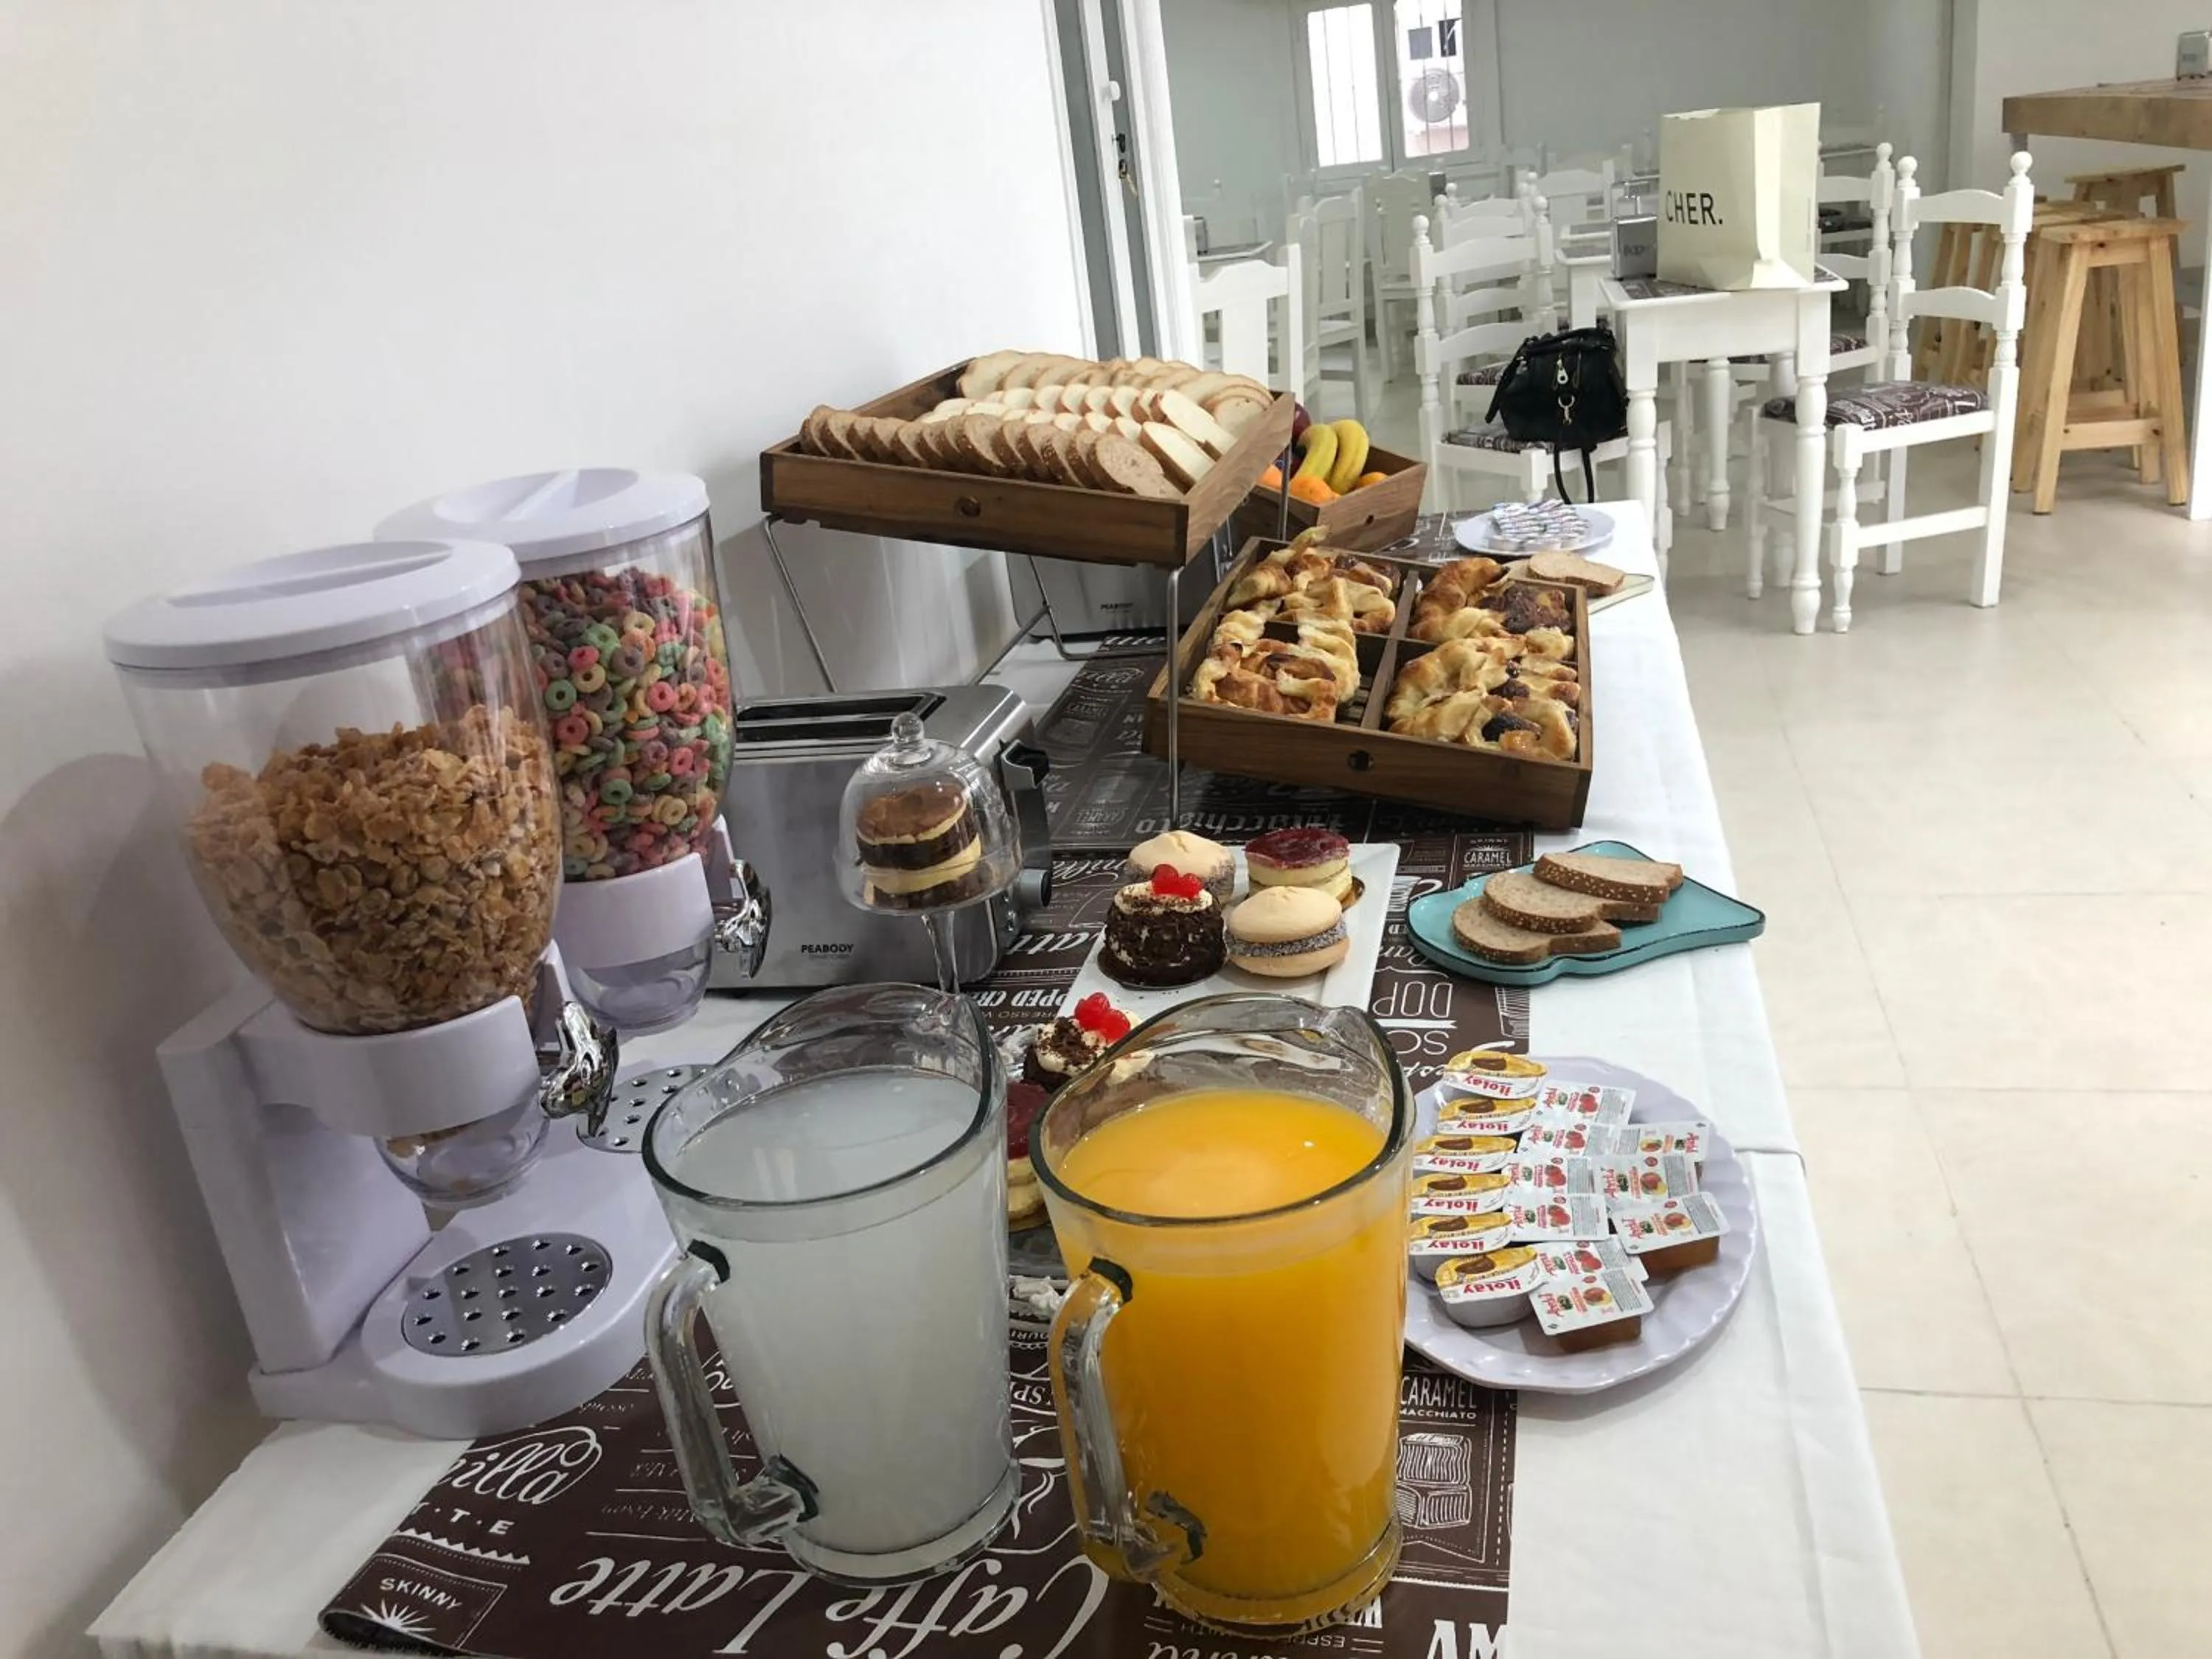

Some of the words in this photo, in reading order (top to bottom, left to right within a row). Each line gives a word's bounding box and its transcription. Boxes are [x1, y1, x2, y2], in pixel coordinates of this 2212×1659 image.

[1666, 190, 1723, 225] CHER.
[1464, 851, 1512, 863] CARAMEL
[801, 943, 854, 953] PEABODY
[1372, 980, 1453, 1018] DOP
[1399, 1375, 1477, 1408] CARAMEL
[379, 1577, 464, 1610] SKINNY
[549, 1557, 812, 1654] Latte
